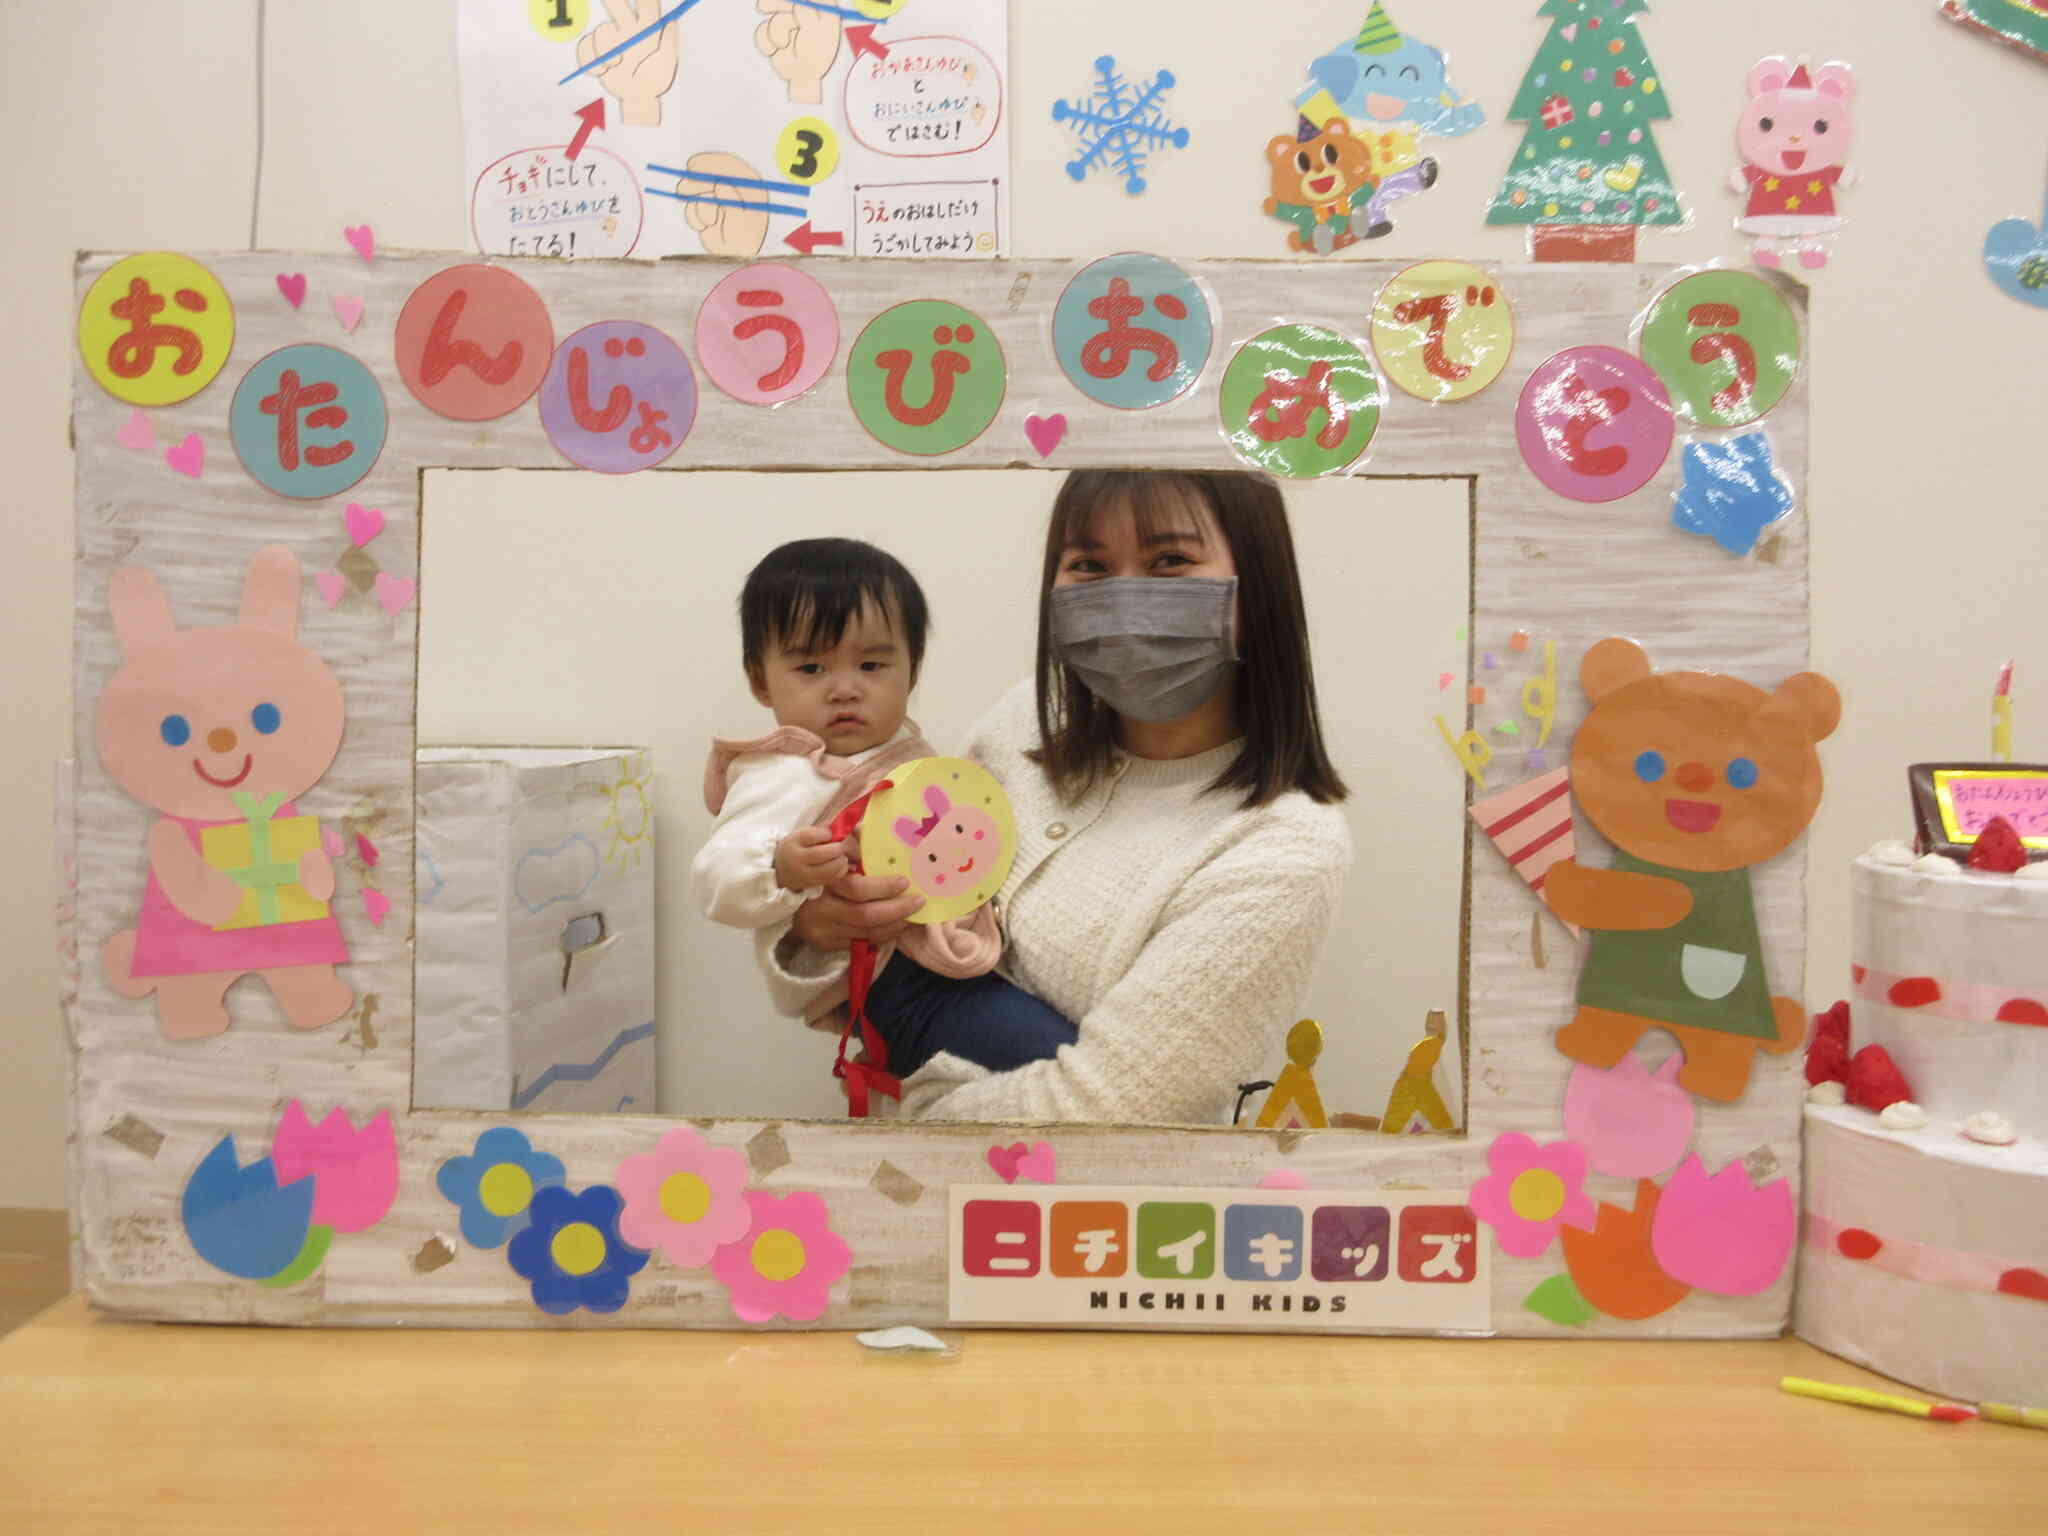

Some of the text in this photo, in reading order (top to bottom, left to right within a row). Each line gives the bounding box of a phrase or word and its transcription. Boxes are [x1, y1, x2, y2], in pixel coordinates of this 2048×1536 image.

[912, 79, 926, 94] と
[790, 130, 824, 178] 3
[863, 199, 979, 224] うえのおはしだけ
[871, 230, 975, 254] うごかしてみよう
[984, 1224, 1474, 1281] ニチイキッズ
[1090, 1290, 1349, 1314] NICHII KIDS
